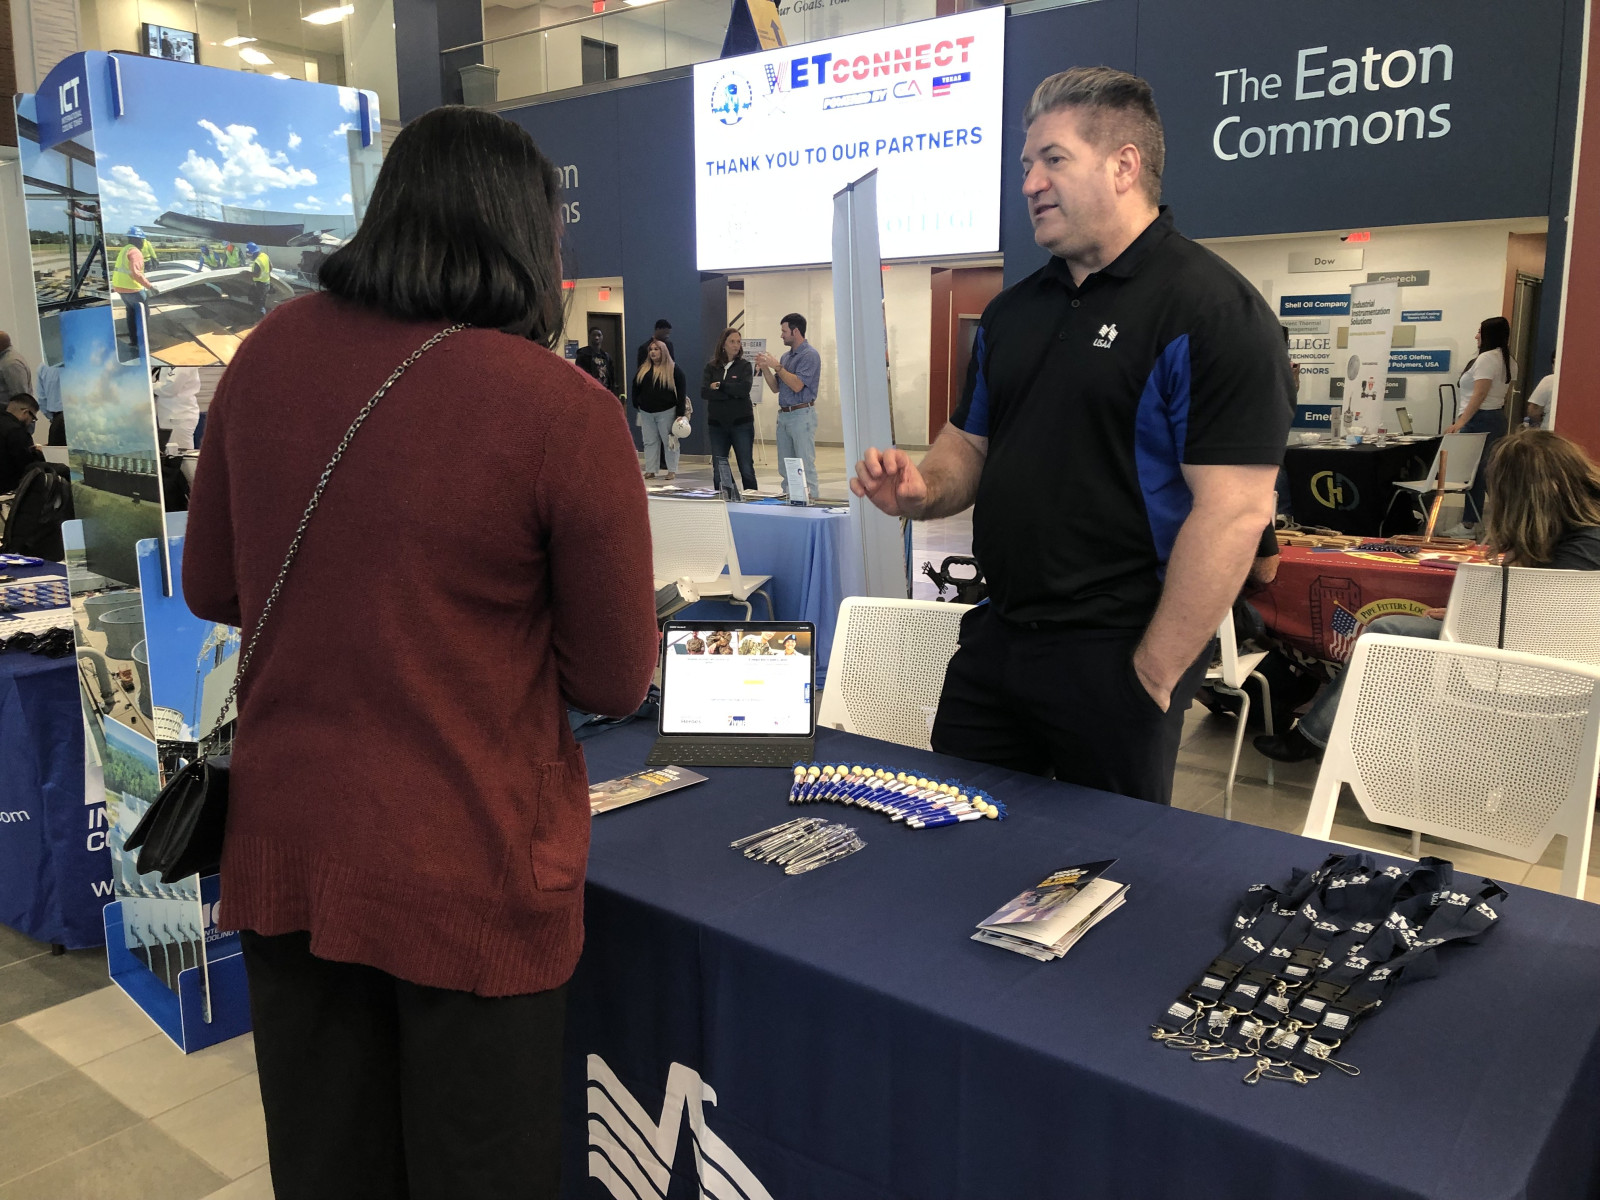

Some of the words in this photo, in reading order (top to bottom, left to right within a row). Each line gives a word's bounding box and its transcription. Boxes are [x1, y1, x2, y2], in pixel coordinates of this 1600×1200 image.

[793, 0, 825, 14] Goals.
[1215, 68, 1282, 105] The
[1295, 43, 1454, 101] Eaton
[59, 76, 80, 115] ICT
[1213, 102, 1452, 161] Commons
[706, 155, 760, 176] THANK
[765, 150, 799, 169] YOU
[804, 146, 827, 163] TO
[832, 141, 870, 161] OUR
[875, 126, 982, 156] PARTNERS
[1314, 257, 1336, 266] Dow
[1284, 301, 1302, 309] Shell
[1314, 300, 1349, 309] Company
[1351, 299, 1376, 309] Industrial
[1351, 307, 1391, 317] Instrumentation
[1350, 318, 1372, 326] Solutions
[1392, 361, 1424, 369] Polymers,
[1345, 962, 1365, 970] USAA
